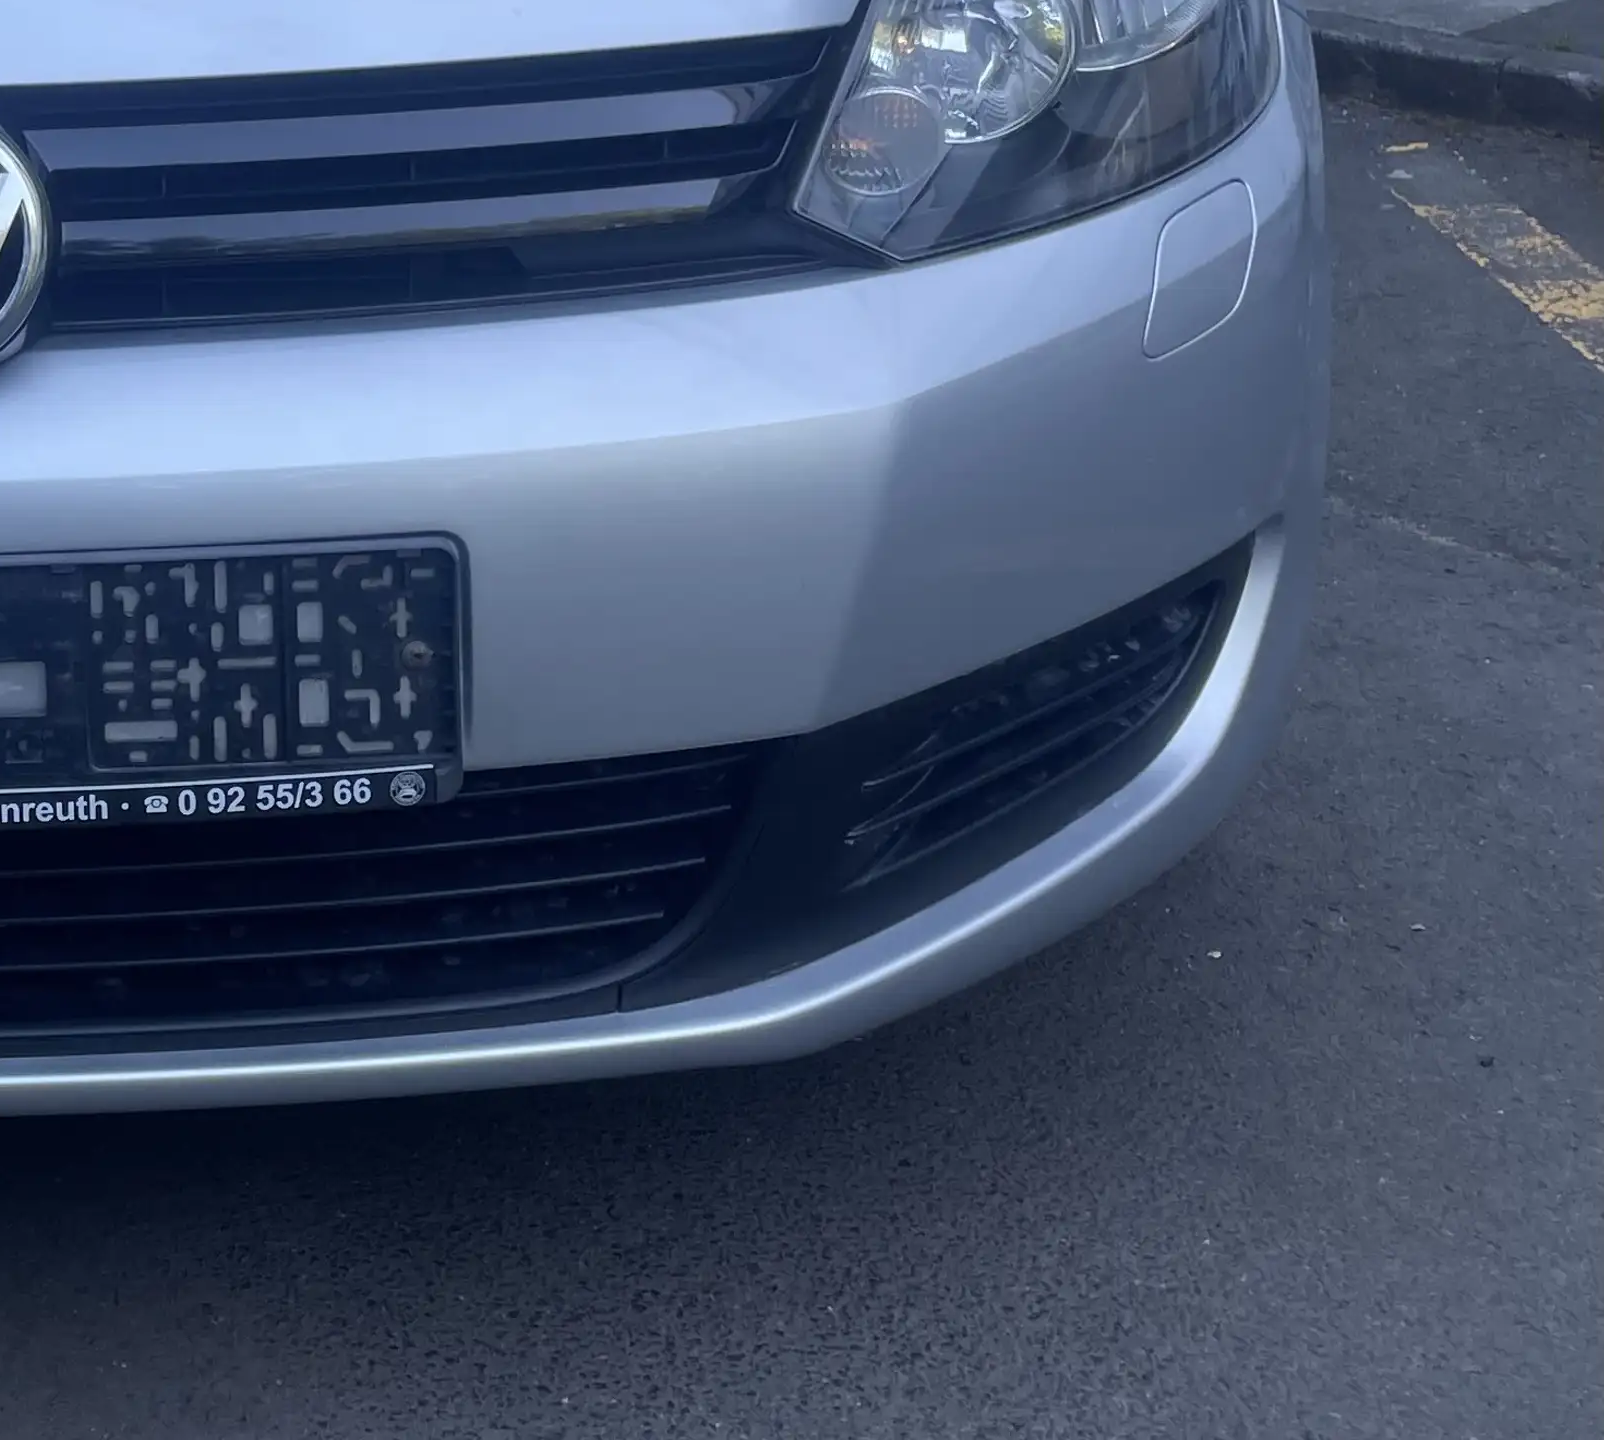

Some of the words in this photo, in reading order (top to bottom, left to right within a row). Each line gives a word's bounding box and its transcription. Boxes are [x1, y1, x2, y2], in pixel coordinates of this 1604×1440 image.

[177, 789, 197, 816] 0
[207, 786, 246, 814] 92
[255, 781, 324, 811] 55/3
[333, 777, 372, 805] 66
